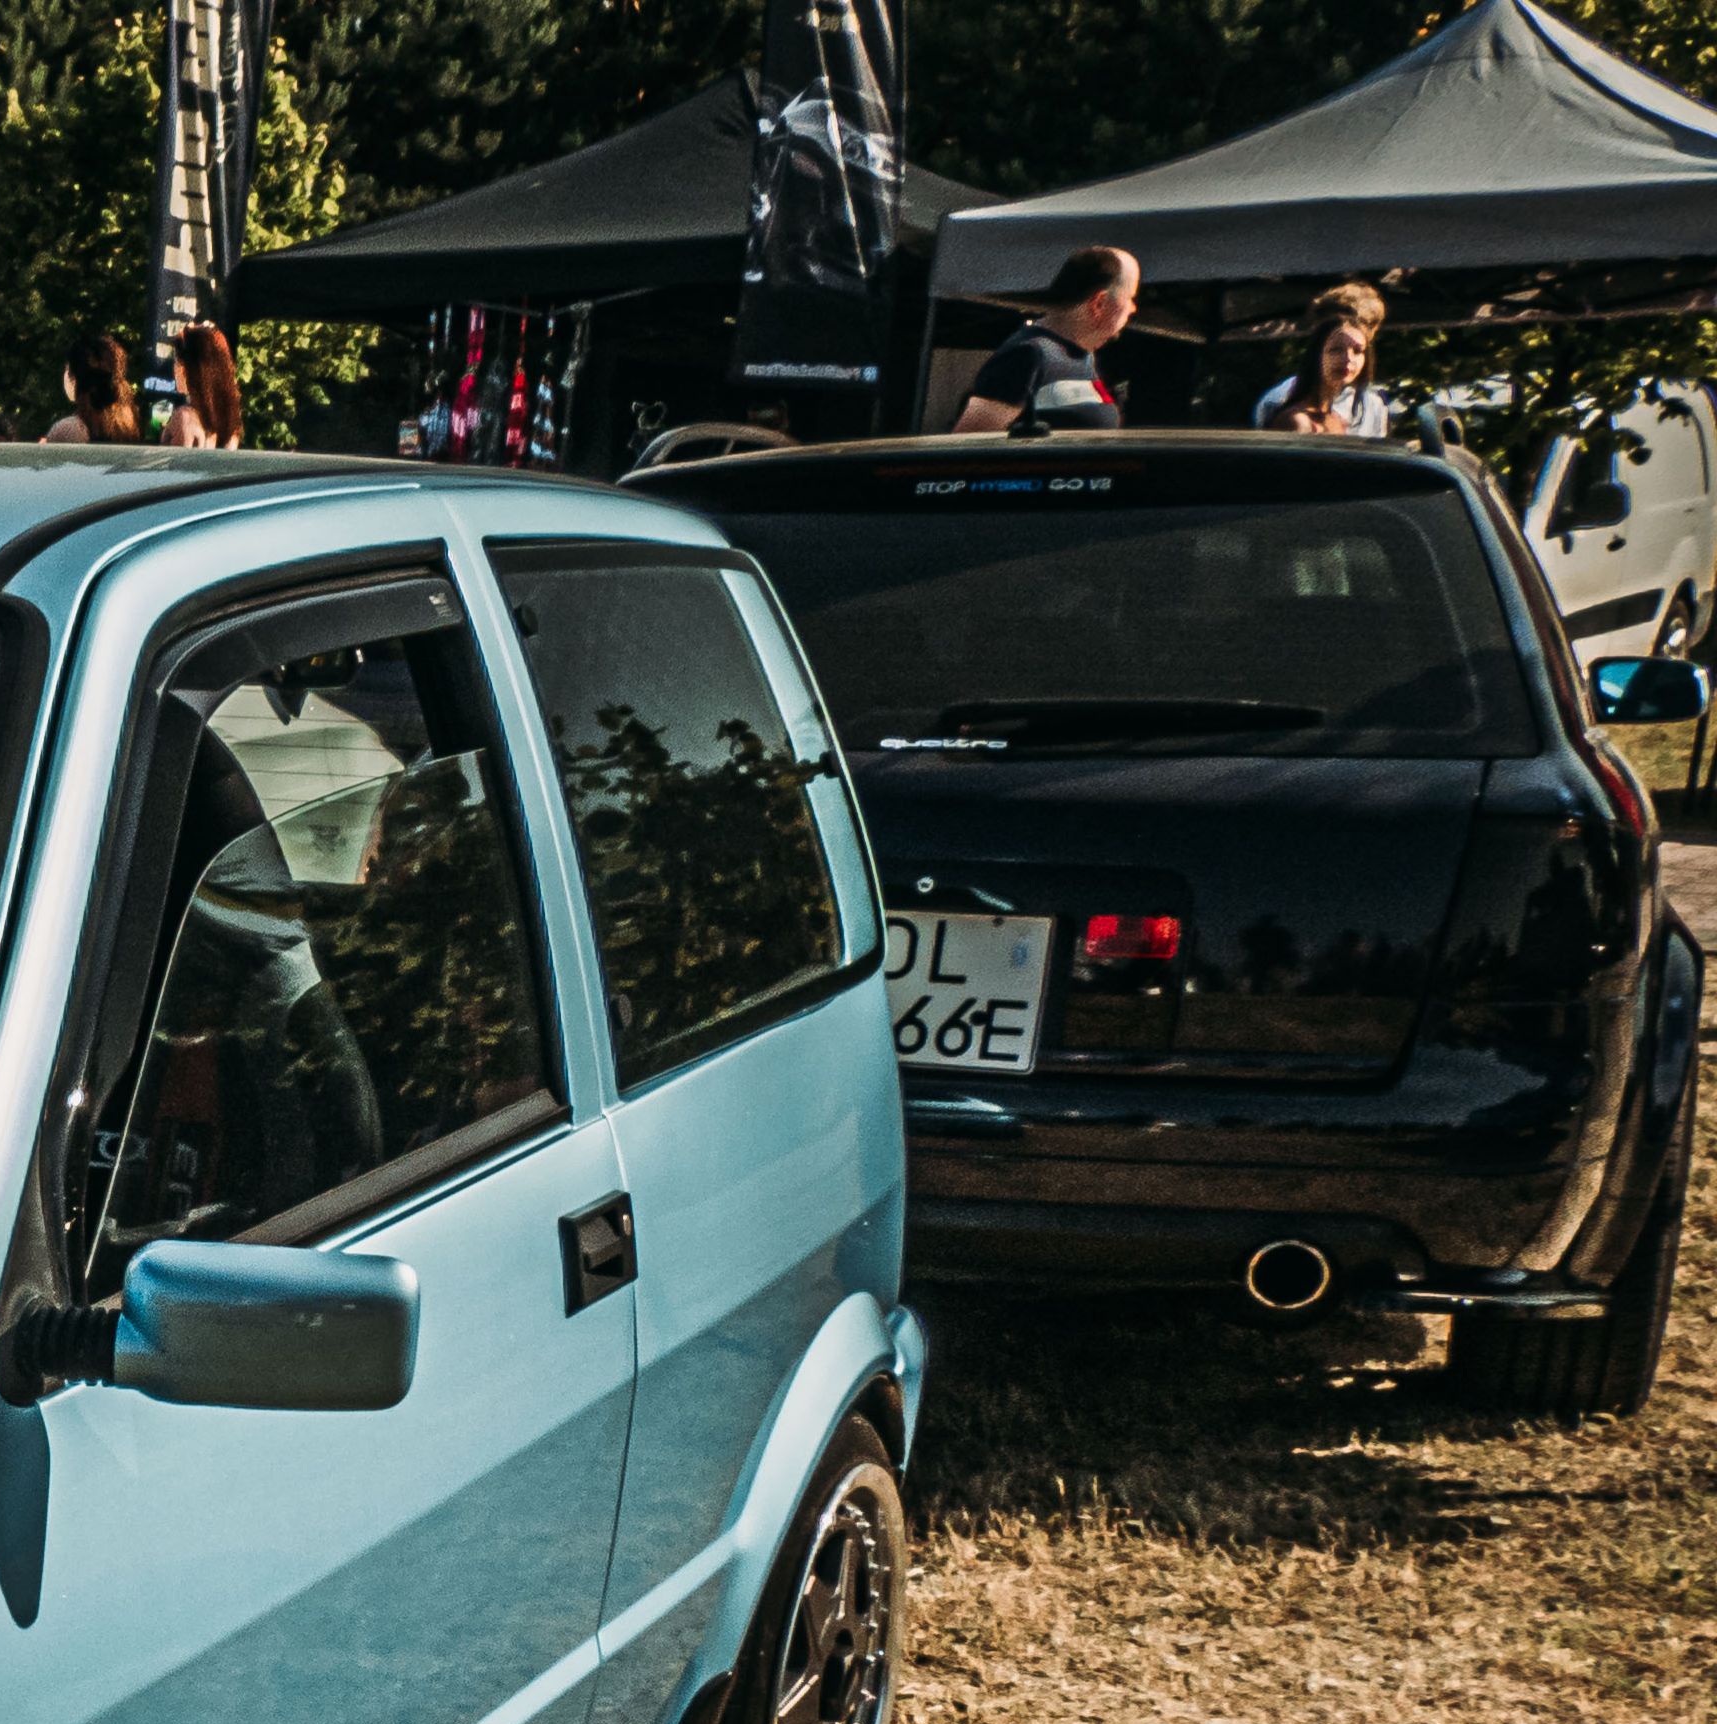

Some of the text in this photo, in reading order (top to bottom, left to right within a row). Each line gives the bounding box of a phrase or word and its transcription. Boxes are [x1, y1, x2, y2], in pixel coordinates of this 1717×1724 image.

[916, 479, 966, 495] STOP
[1048, 477, 1084, 491] GO
[880, 738, 1007, 749] quattro
